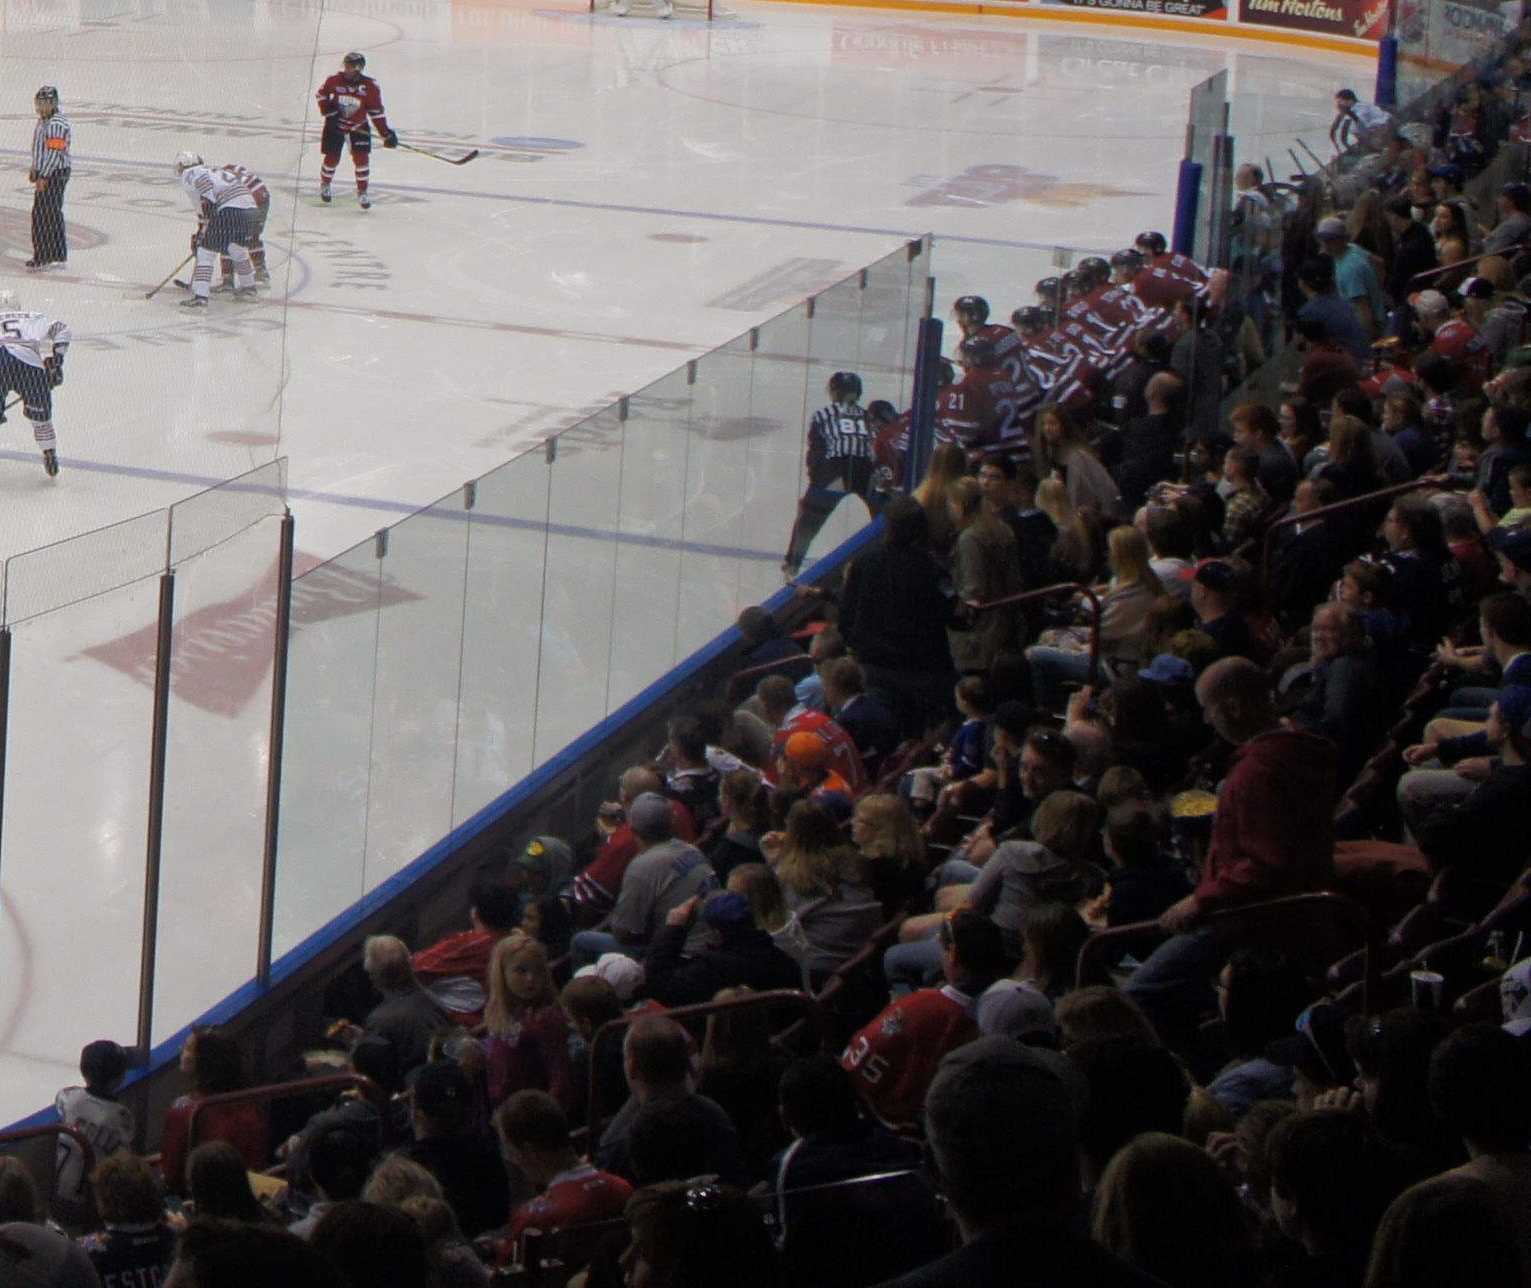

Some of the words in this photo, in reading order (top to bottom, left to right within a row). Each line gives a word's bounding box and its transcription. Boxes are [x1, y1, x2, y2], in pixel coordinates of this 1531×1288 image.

[1145, 0, 1162, 12] BE
[1164, 1, 1206, 16] GREAT
[1, 319, 22, 339] 5
[948, 393, 965, 411] 21
[839, 418, 868, 436] 81
